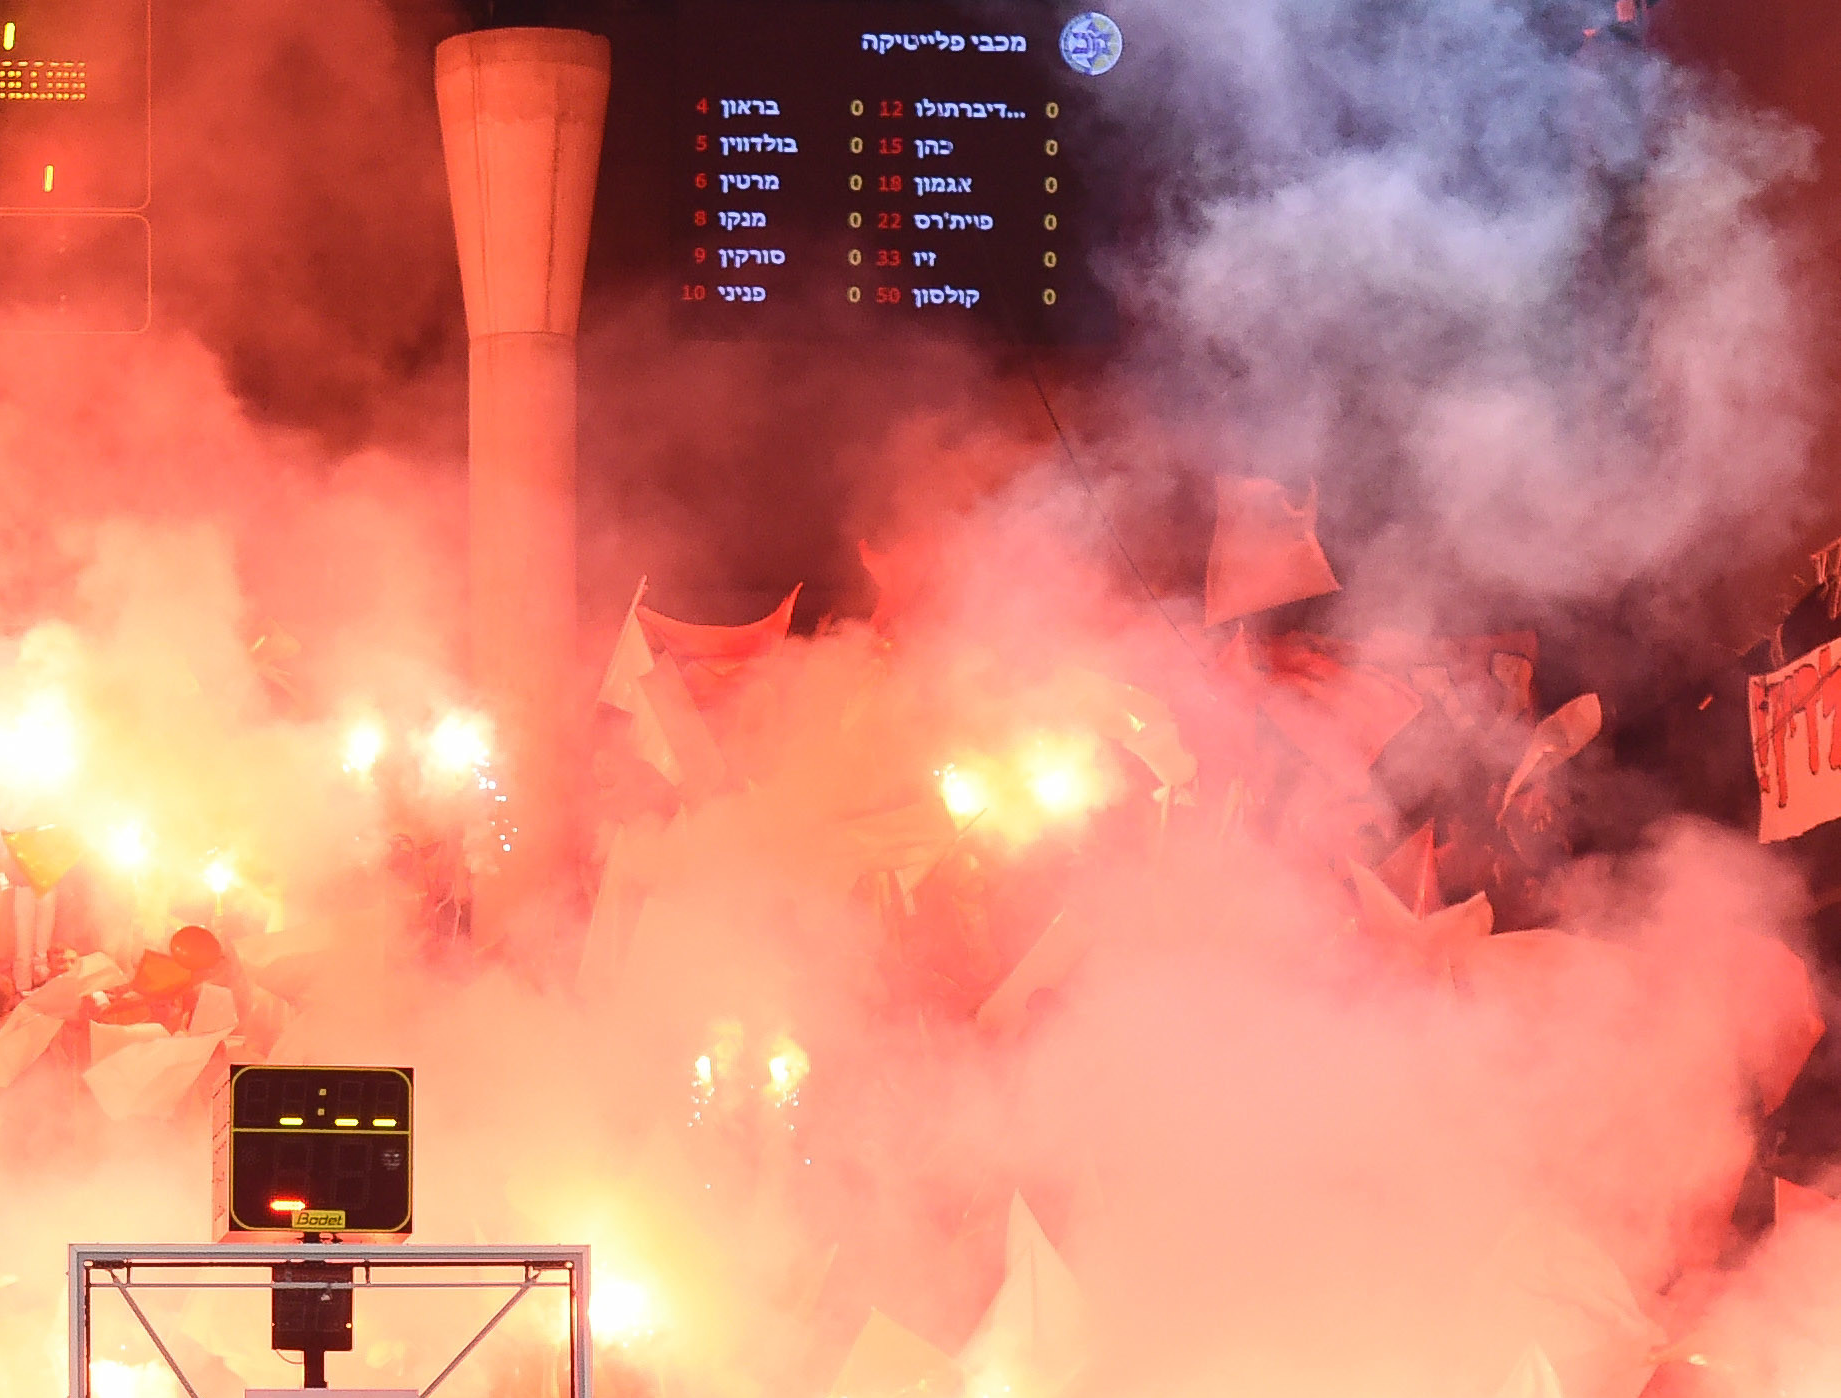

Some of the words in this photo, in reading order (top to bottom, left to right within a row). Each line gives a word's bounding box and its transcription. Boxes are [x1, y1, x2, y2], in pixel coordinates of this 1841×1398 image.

[861, 30, 965, 54] פלייטיקה
[970, 35, 1027, 52] מכבי
[696, 98, 710, 114] 4
[720, 99, 781, 119] בראון
[850, 99, 864, 116] 0
[880, 100, 904, 118] 12
[1045, 102, 1059, 119] 0
[696, 134, 708, 153] 5
[719, 133, 799, 156] בולדווין
[850, 137, 863, 154] 0
[880, 136, 904, 155] 15
[914, 139, 954, 159] כהן
[1045, 139, 1058, 156] 0
[694, 172, 708, 189] 6
[719, 174, 780, 194] מרטין
[849, 174, 863, 191] 0
[913, 176, 972, 197] אגמון
[1044, 176, 1058, 194] 0
[694, 209, 708, 227] 8
[718, 211, 767, 231] מנקו
[849, 212, 862, 228] 0
[878, 212, 902, 230] 22
[1044, 214, 1058, 231] 0
[694, 247, 708, 264] 9
[718, 248, 786, 269] סורקין
[848, 249, 862, 266] 0
[876, 249, 902, 267] 33
[913, 251, 937, 267] זיו
[1043, 251, 1057, 268] 0
[682, 284, 707, 301] 10
[717, 286, 766, 302] פניני
[848, 286, 861, 303] 0
[912, 285, 980, 309] קולסון
[1043, 288, 1057, 305] 0
[296, 1212, 344, 1227] Bodet
